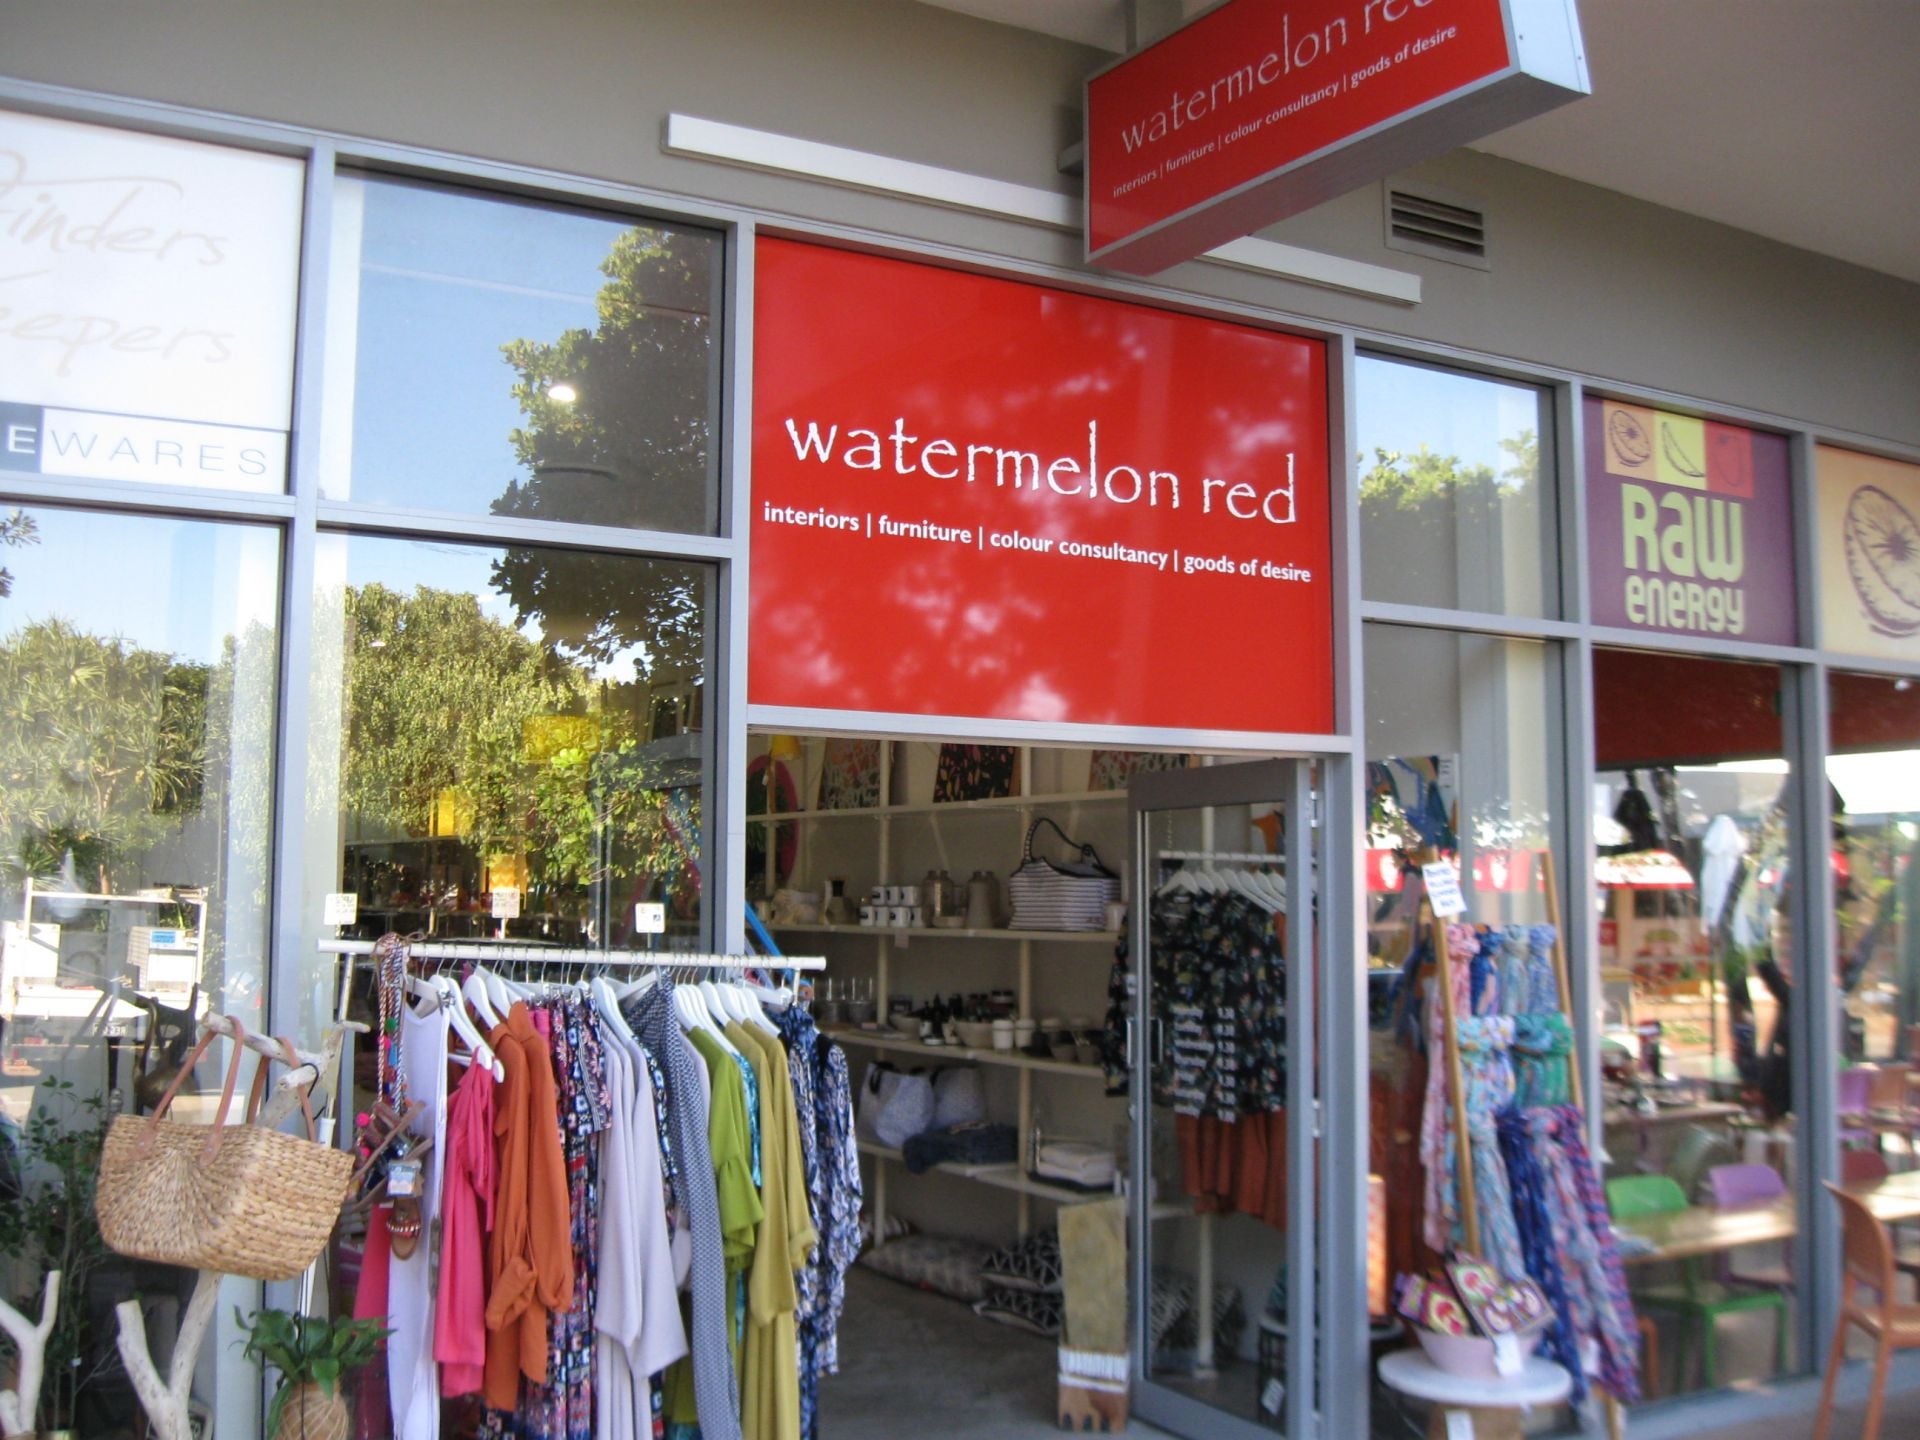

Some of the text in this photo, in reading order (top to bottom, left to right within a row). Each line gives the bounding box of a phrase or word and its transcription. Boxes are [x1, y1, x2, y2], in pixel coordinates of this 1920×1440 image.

[1113, 168, 1157, 198] interiors
[1166, 142, 1215, 173] furniture
[1224, 117, 1263, 144] colour
[1265, 80, 1339, 125] consultancy
[1350, 56, 1391, 89] goods
[1394, 43, 1409, 63] of
[1412, 26, 1456, 55] desire
[1121, 0, 1434, 154] watermelon re
[785, 417, 1296, 524] watermelon red
[764, 501, 859, 531] interiors
[878, 515, 972, 544] furniture
[990, 531, 1053, 552] colour
[1059, 542, 1168, 571] consultancy
[1184, 554, 1235, 575] goods
[1239, 558, 1258, 576] of
[1261, 562, 1311, 583] desire
